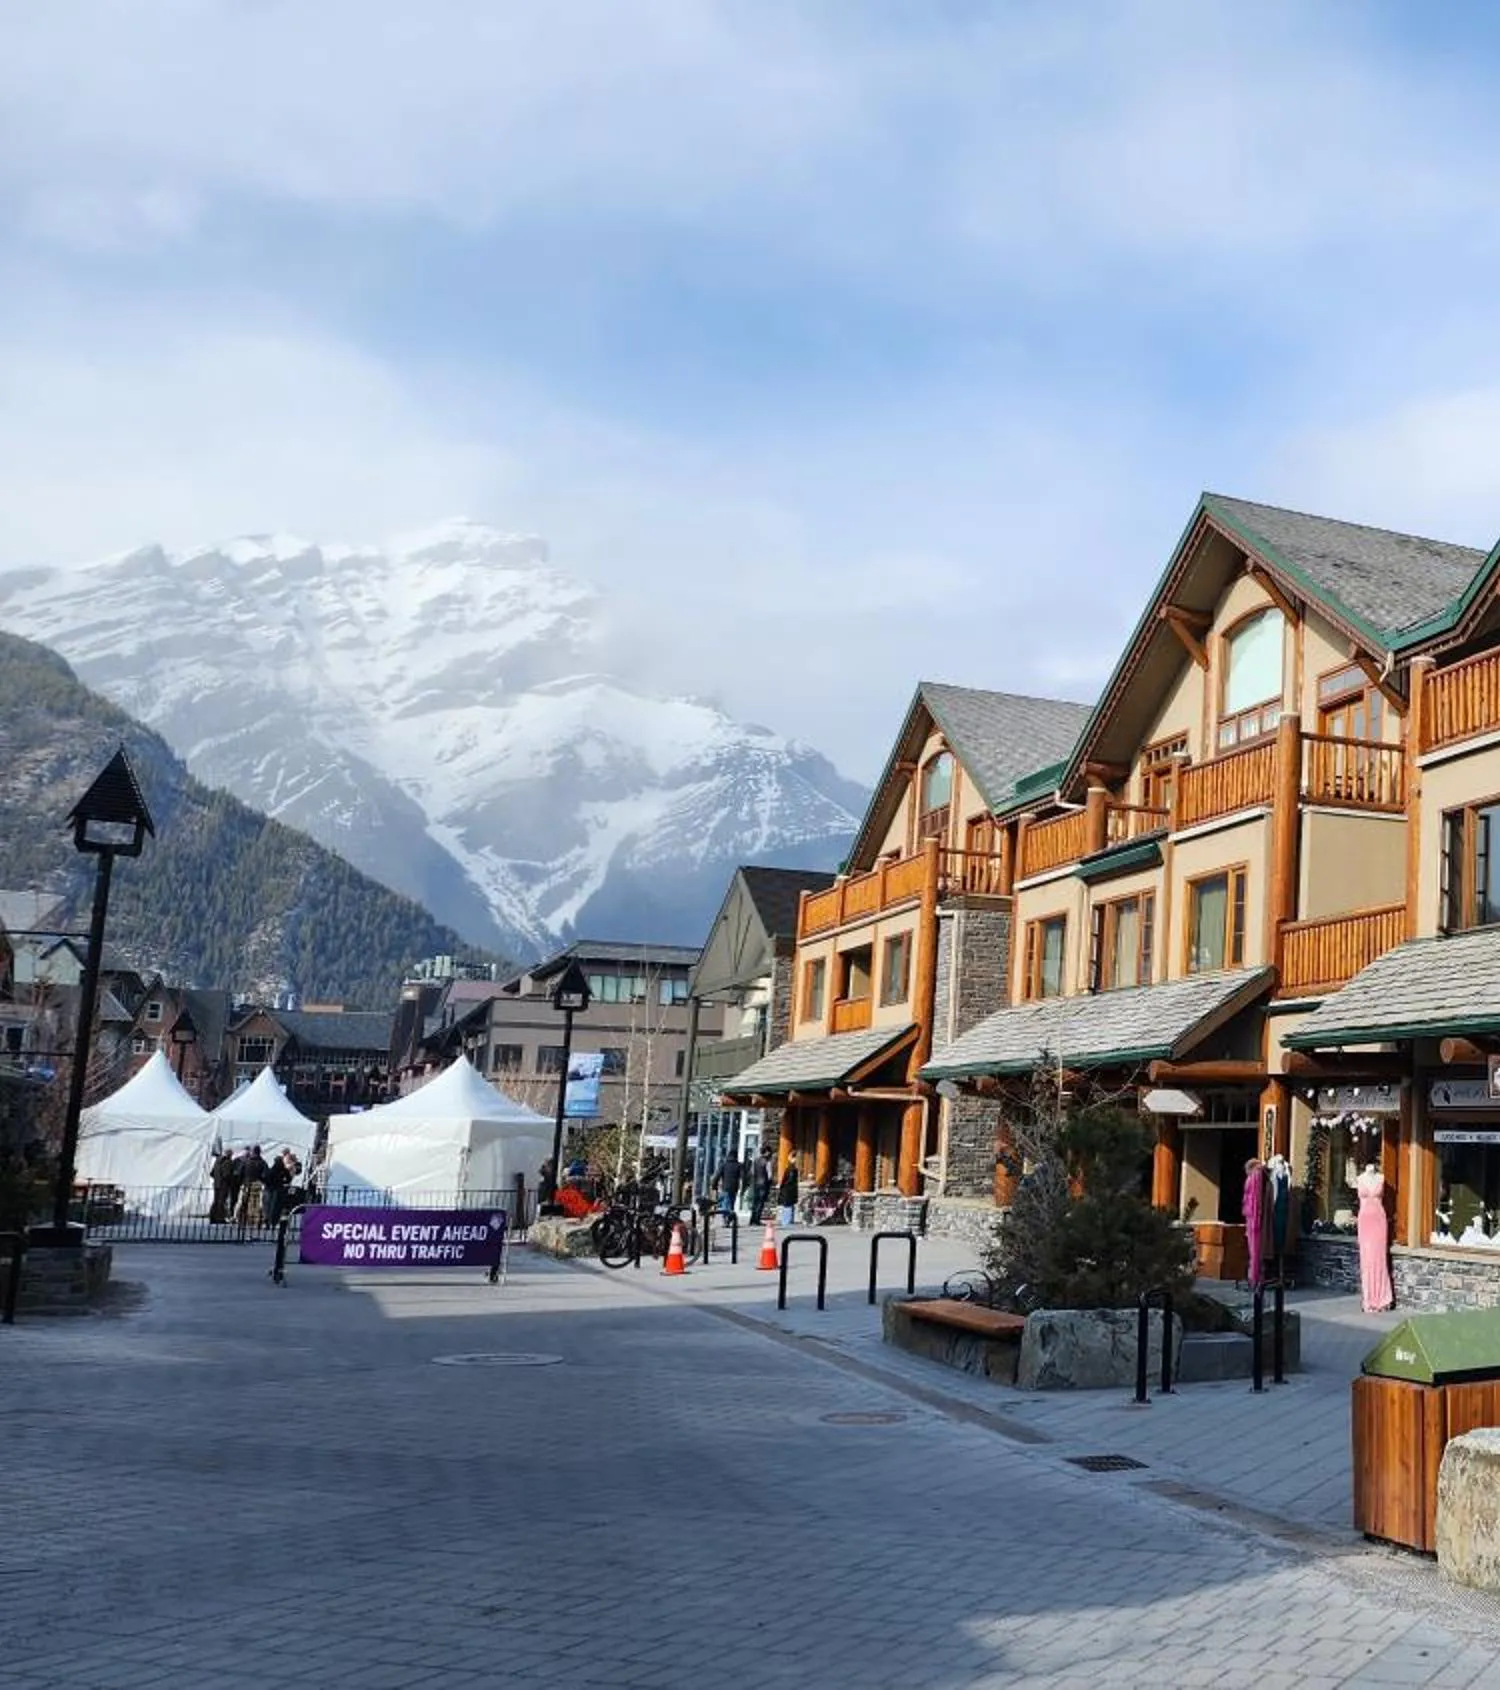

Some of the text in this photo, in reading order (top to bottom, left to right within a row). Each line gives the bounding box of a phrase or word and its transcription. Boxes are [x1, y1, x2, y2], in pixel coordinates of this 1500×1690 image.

[321, 1223, 488, 1241] SPECIAL EVENT AHEAD
[343, 1244, 465, 1259] NO THRU TRAFFIC
